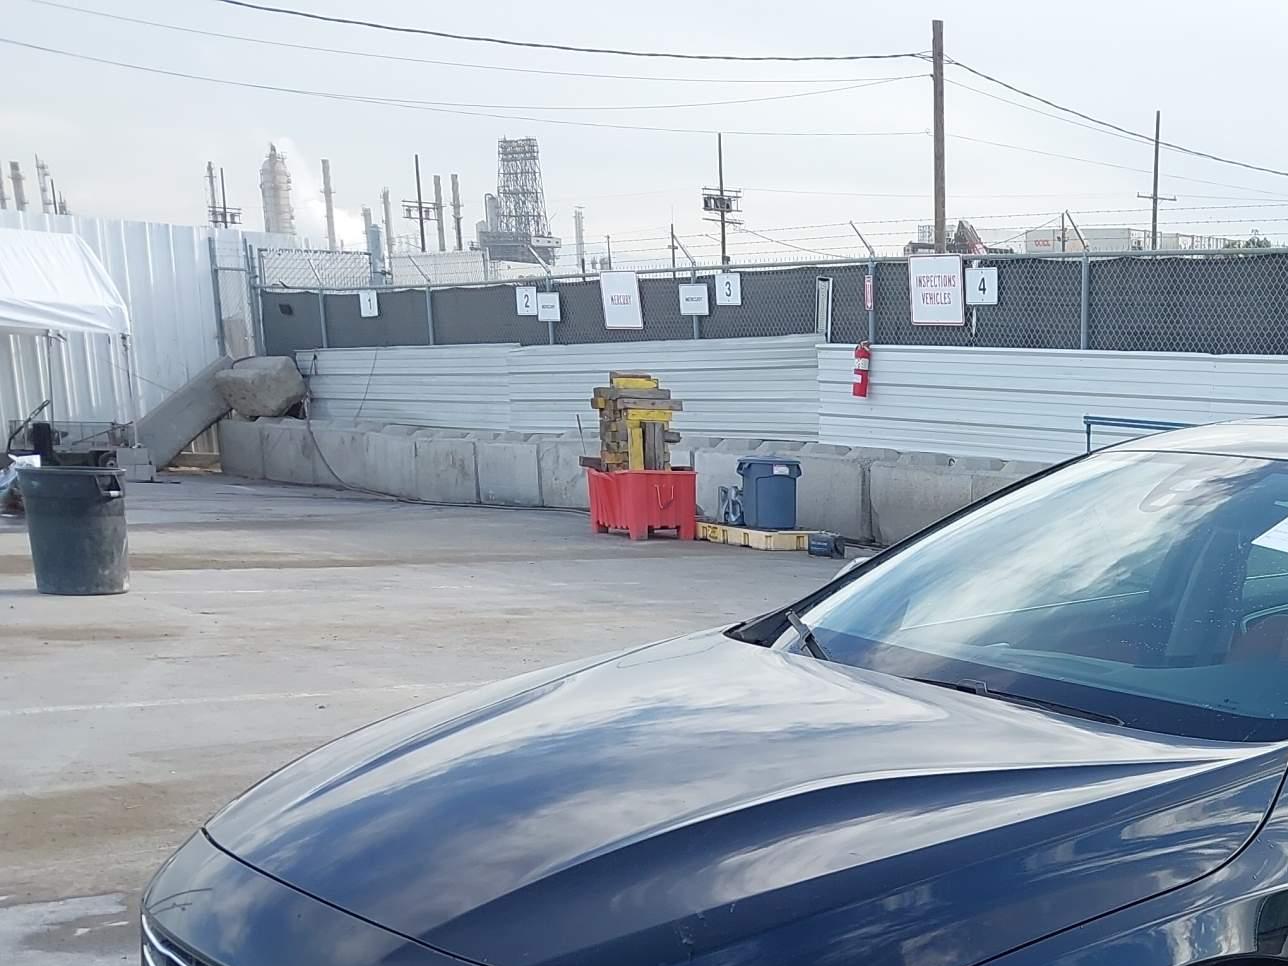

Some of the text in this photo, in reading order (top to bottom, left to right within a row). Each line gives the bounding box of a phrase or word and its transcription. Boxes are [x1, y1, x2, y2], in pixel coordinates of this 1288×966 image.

[915, 274, 956, 288] INSPECTIONS
[978, 276, 987, 295] 4
[724, 281, 732, 297] 3
[523, 294, 531, 308] 2
[921, 292, 952, 305] VEHICLES
